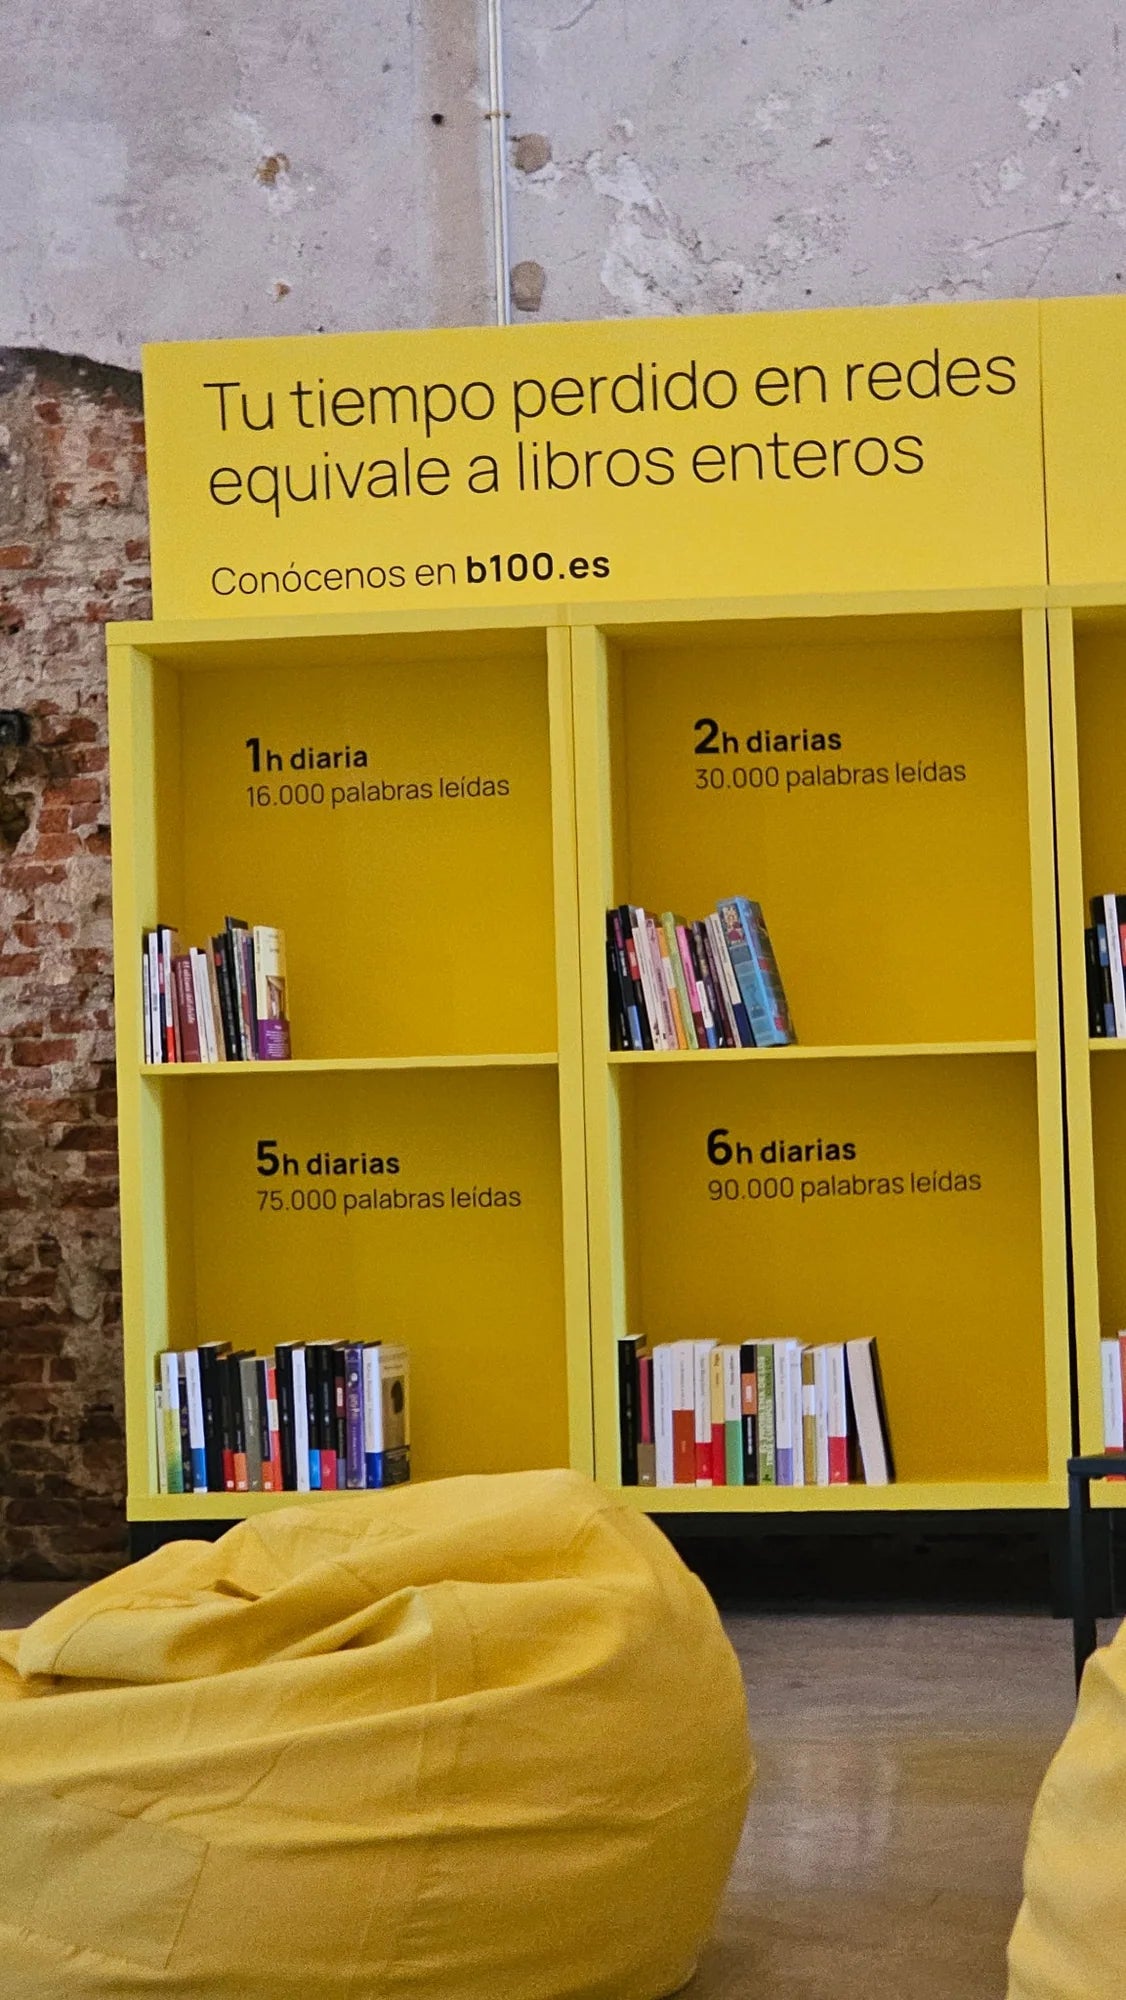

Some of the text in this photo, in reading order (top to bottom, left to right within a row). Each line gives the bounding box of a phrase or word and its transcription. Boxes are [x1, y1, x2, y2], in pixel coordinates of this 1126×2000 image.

[202, 347, 1016, 438] Tu tiempo perdido en redes
[209, 432, 924, 518] equivale a libros enteros
[212, 552, 610, 595] Conócenos en b100.es
[694, 718, 841, 754] 2h diarias
[246, 738, 367, 772] 1h diaria
[247, 776, 509, 809] 16.000 palabras leídas
[696, 760, 966, 793] 30.000 palabras leídas
[257, 1140, 400, 1176] 5h diarias
[707, 1128, 856, 1166] 6h diarias
[257, 1185, 521, 1216] 75.000 palabras leídas
[708, 1170, 981, 1203] 90.000 palabras leídas
